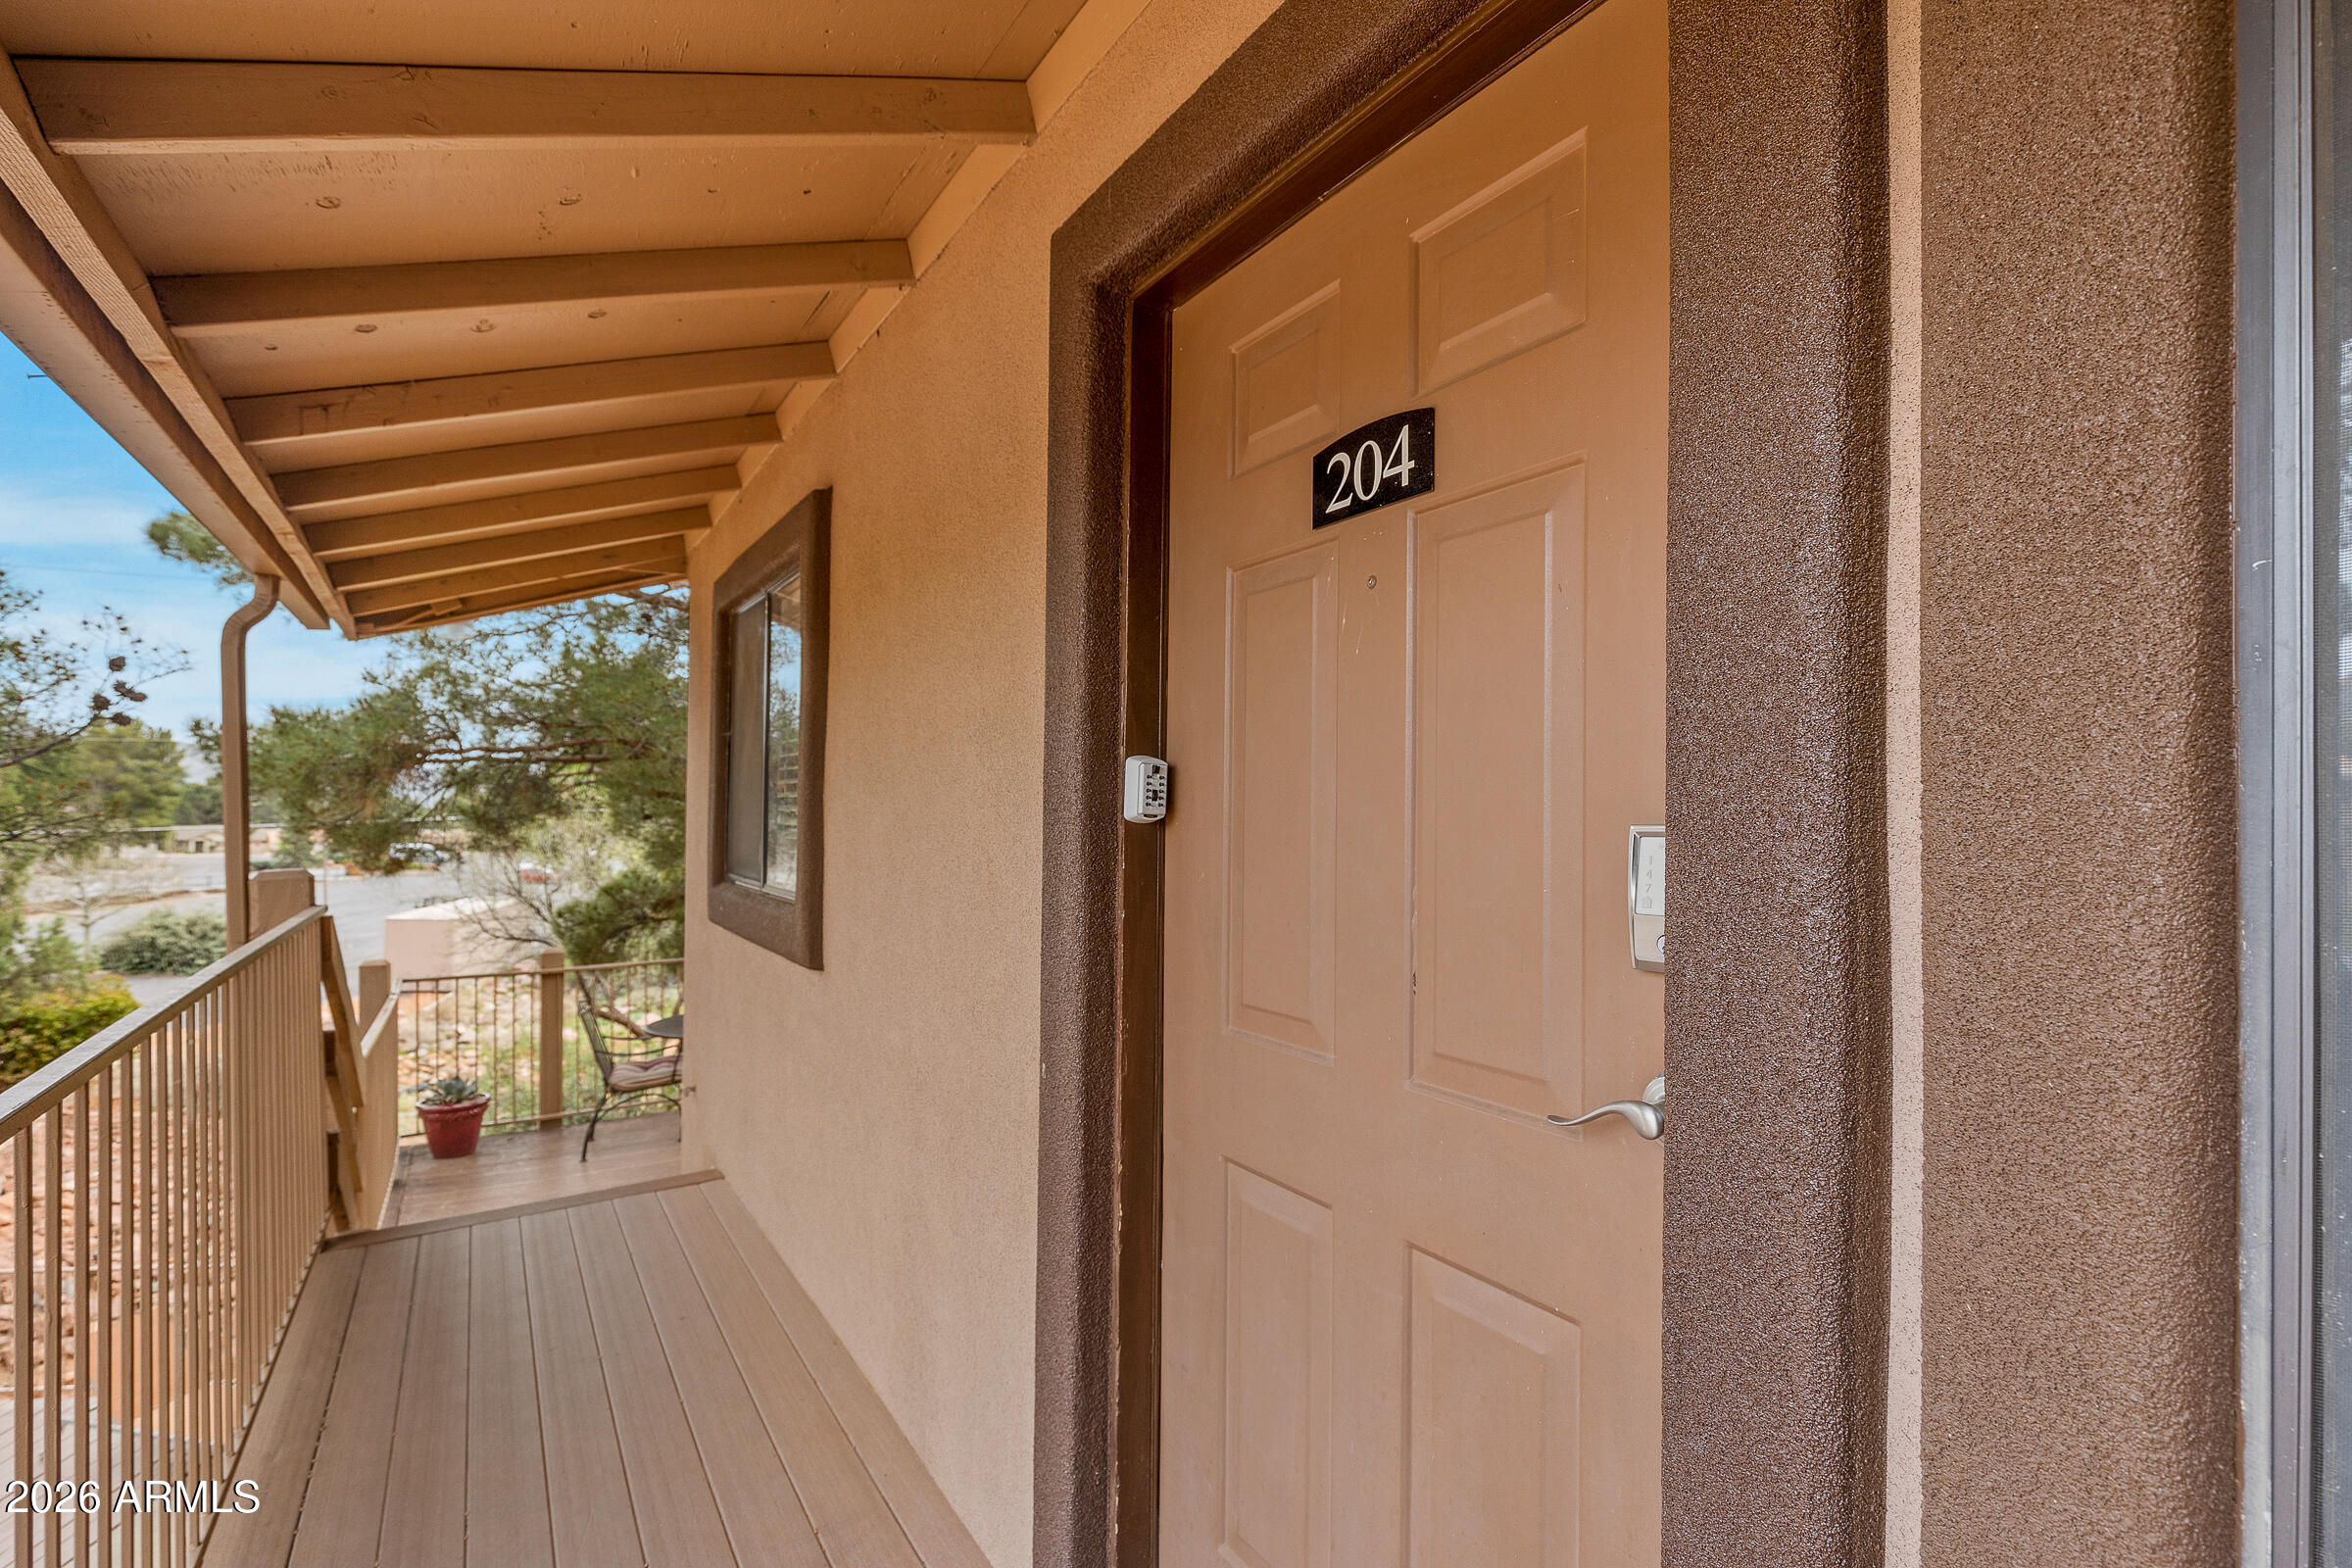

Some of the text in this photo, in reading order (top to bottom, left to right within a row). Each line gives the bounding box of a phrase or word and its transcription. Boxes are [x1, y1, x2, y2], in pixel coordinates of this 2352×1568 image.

[1326, 424, 1414, 514] 204
[1646, 870, 1652, 879] 4
[1645, 884, 1651, 893] 7
